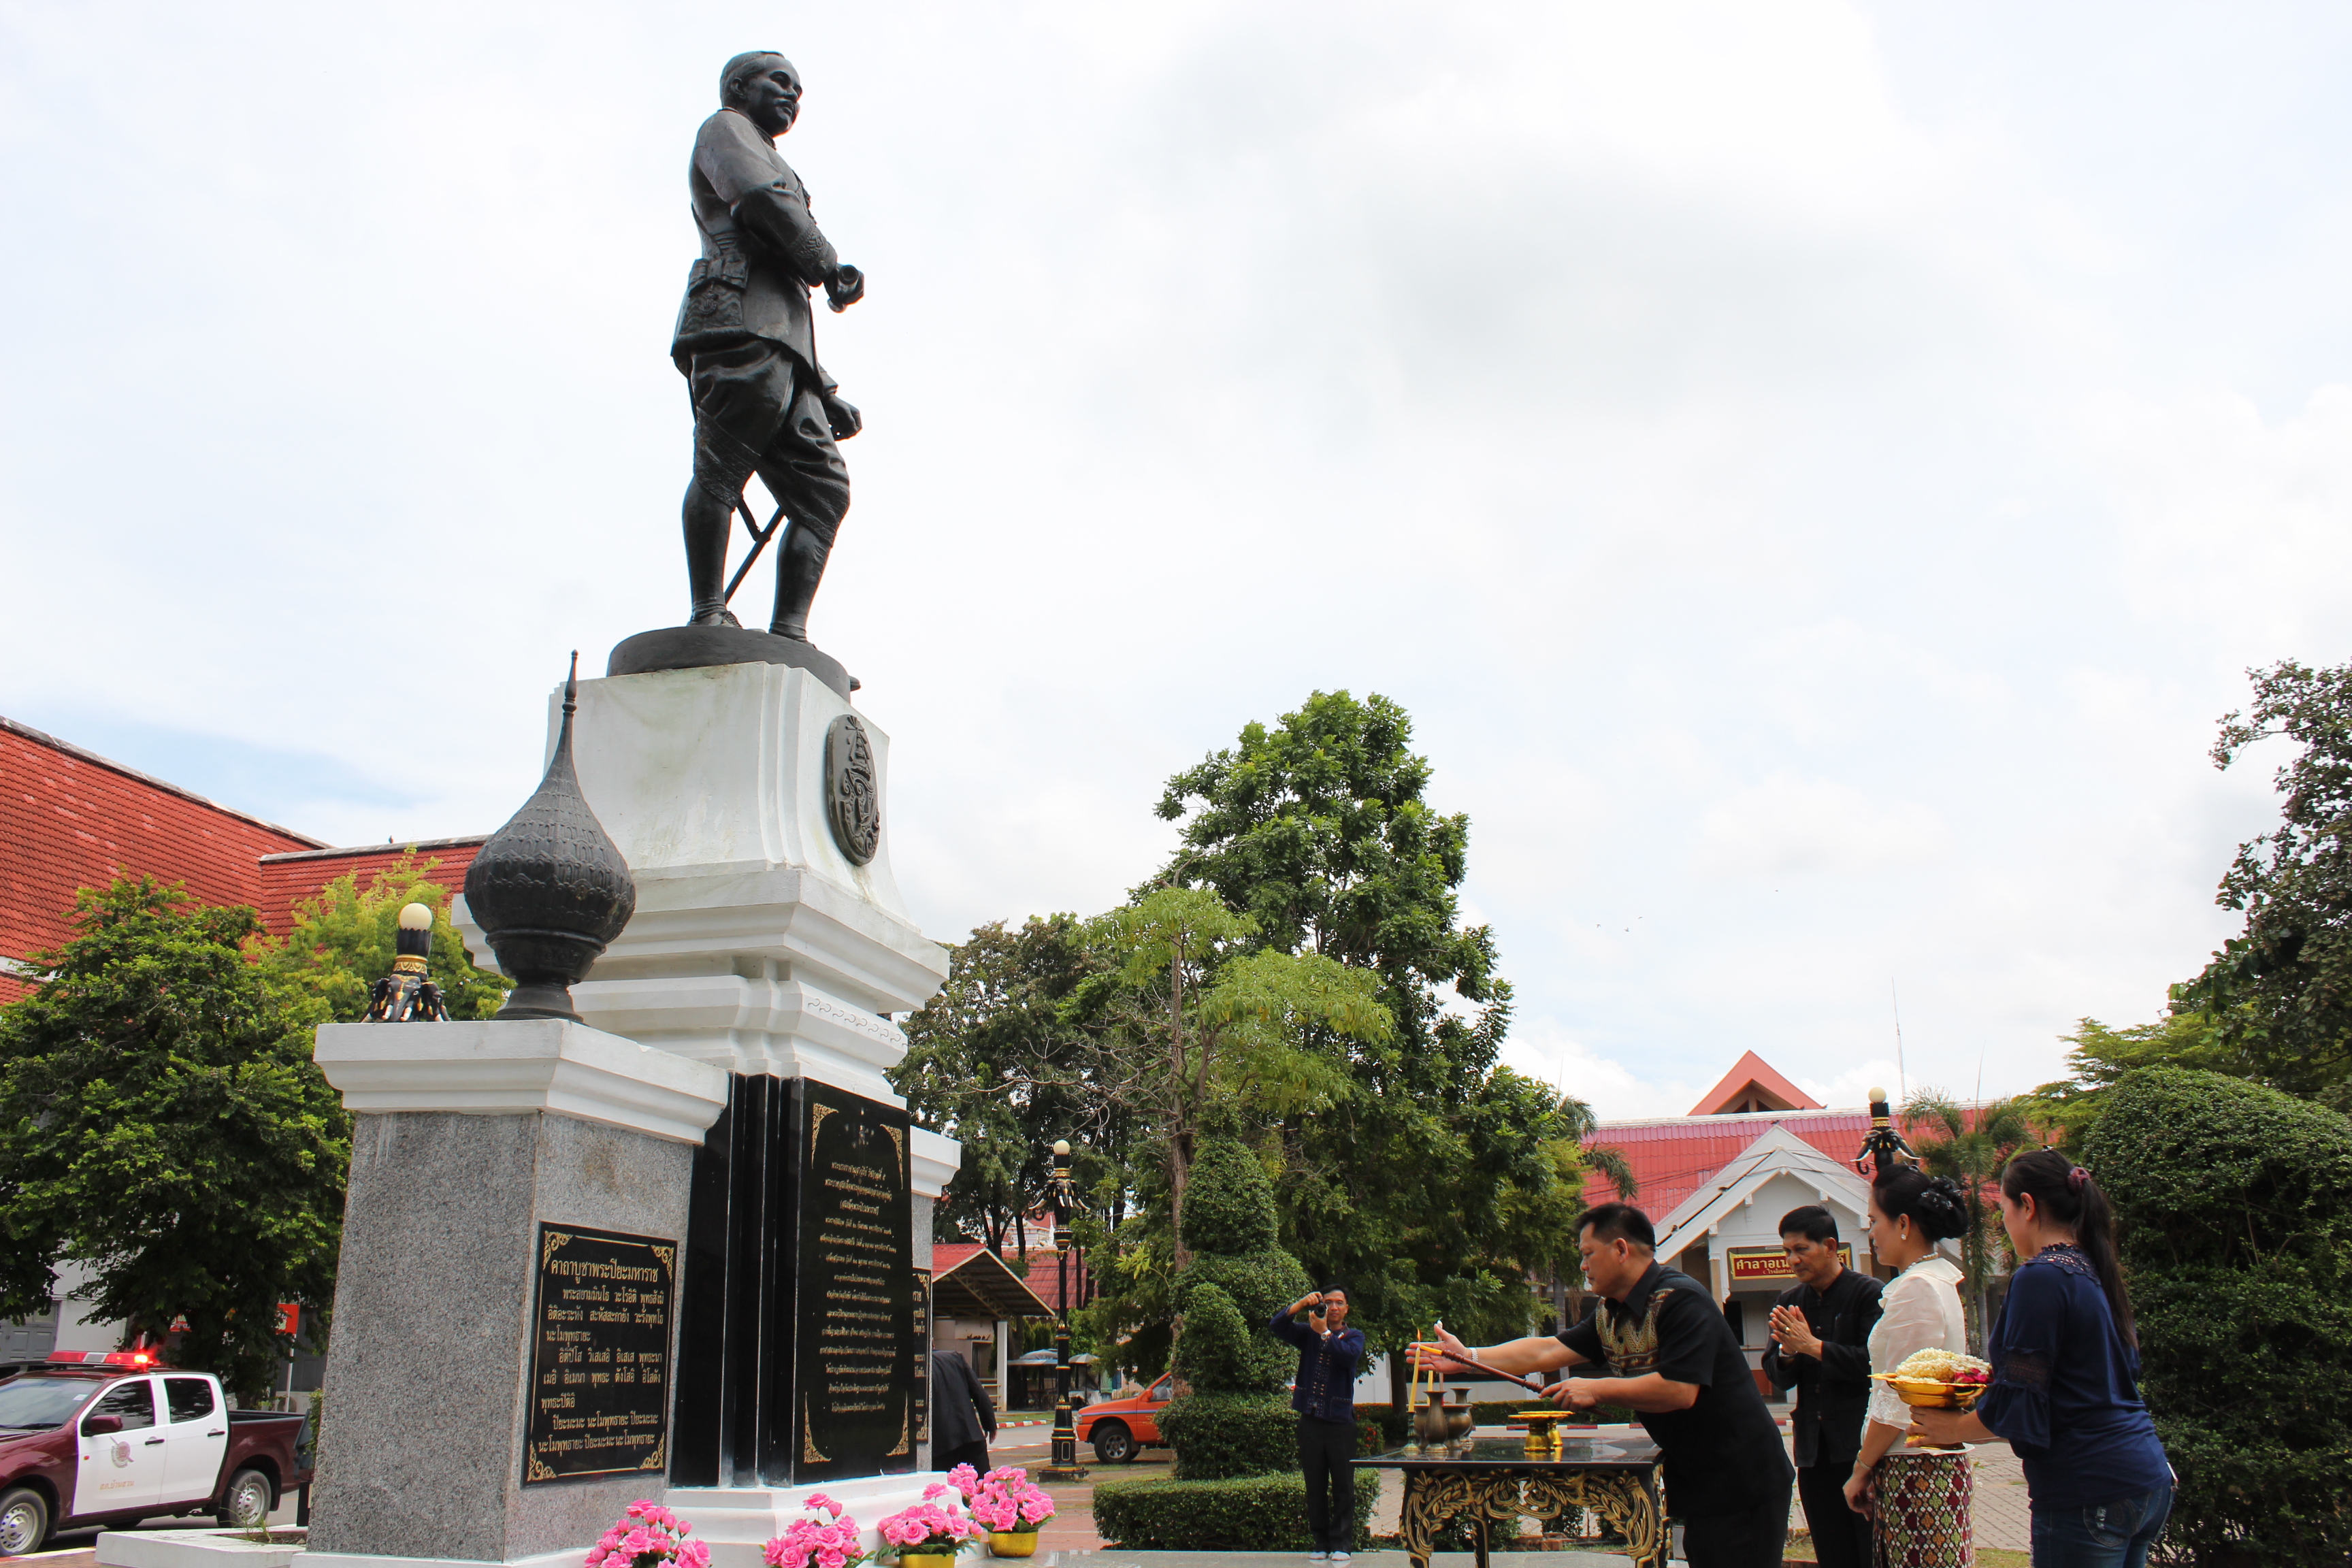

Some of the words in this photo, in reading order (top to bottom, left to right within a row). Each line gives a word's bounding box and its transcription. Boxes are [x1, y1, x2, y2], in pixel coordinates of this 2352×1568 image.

[551, 1258, 659, 1284] คาถาบูชาพระปิยะมหาราช
